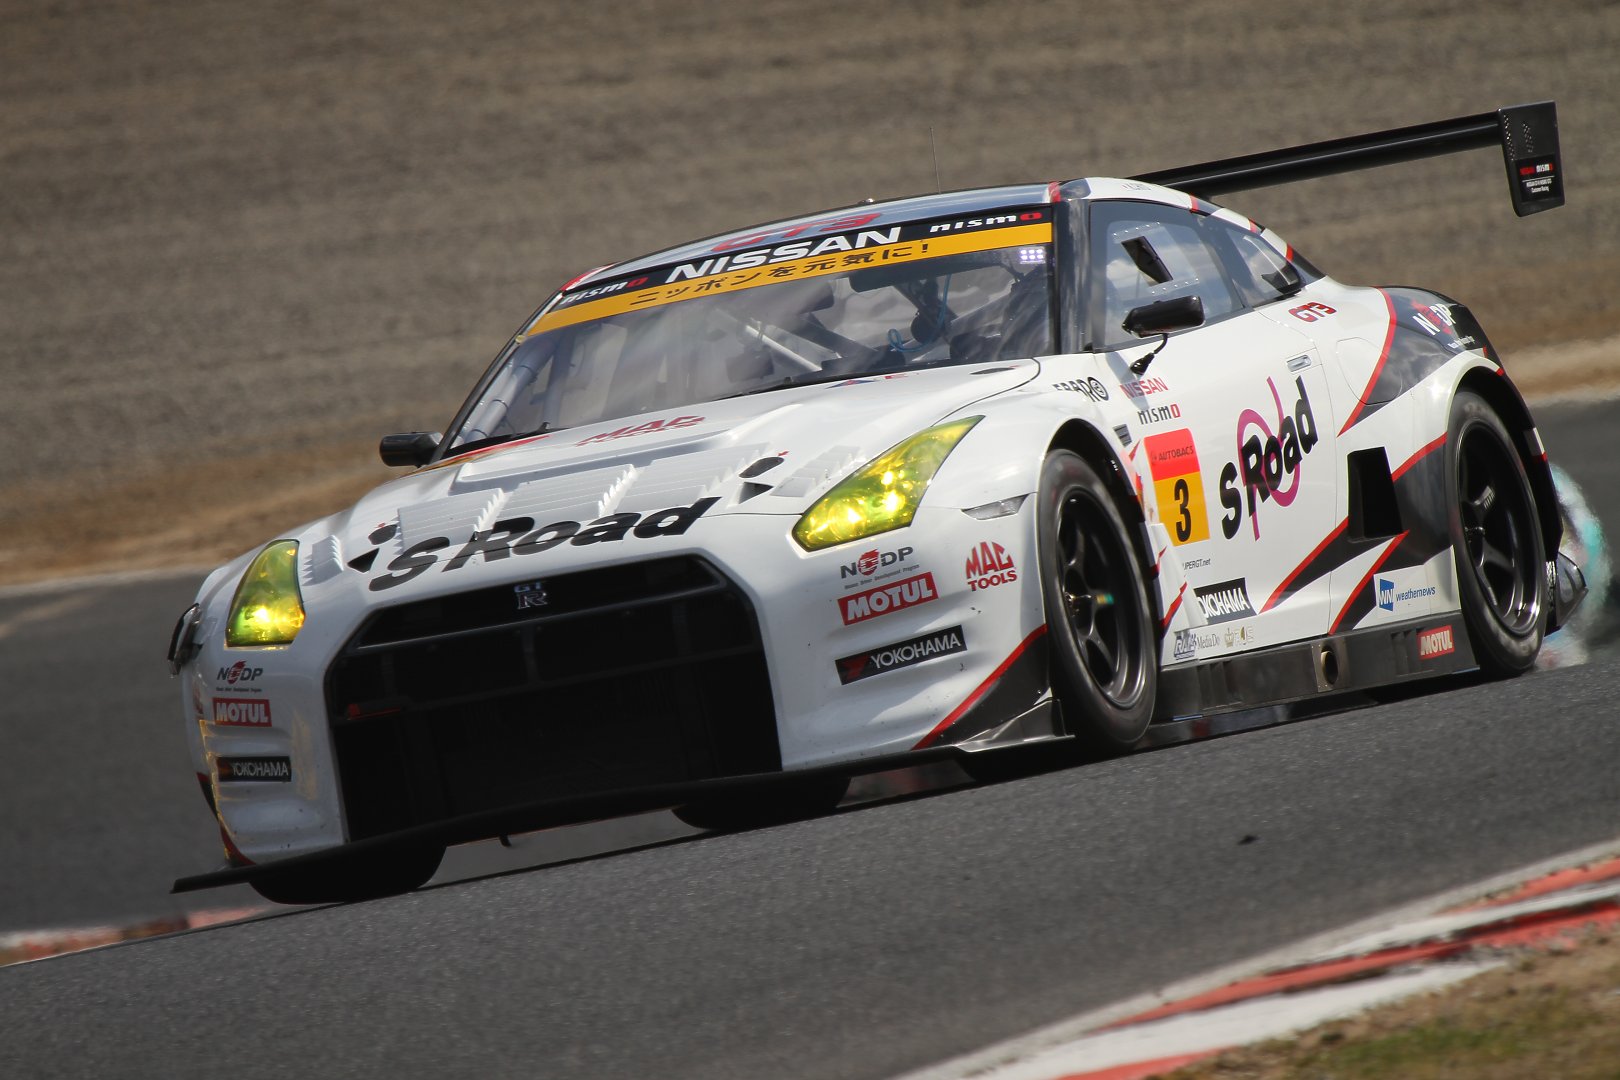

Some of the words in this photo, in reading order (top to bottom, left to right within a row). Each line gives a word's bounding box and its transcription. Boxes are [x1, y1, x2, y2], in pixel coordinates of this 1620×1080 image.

[929, 212, 1043, 233] nismo
[665, 227, 902, 284] NISSAN
[1288, 301, 1337, 323] GT3
[1119, 376, 1169, 400] NISSAN
[1158, 445, 1195, 463] AUTOBACS
[1173, 478, 1192, 543] 3
[965, 541, 1015, 579] MAC
[1182, 557, 1211, 571] UPERGT.net
[967, 569, 1018, 591] TOOLS
[847, 577, 933, 621] MOTUL
[1197, 587, 1250, 619] OKOHAMA
[1396, 585, 1436, 602] weathernews
[870, 632, 962, 669] YOKOHAMA
[1420, 630, 1453, 657] MOTUL
[216, 702, 269, 724] MOTUL
[231, 761, 289, 777] YOKOHAMA
